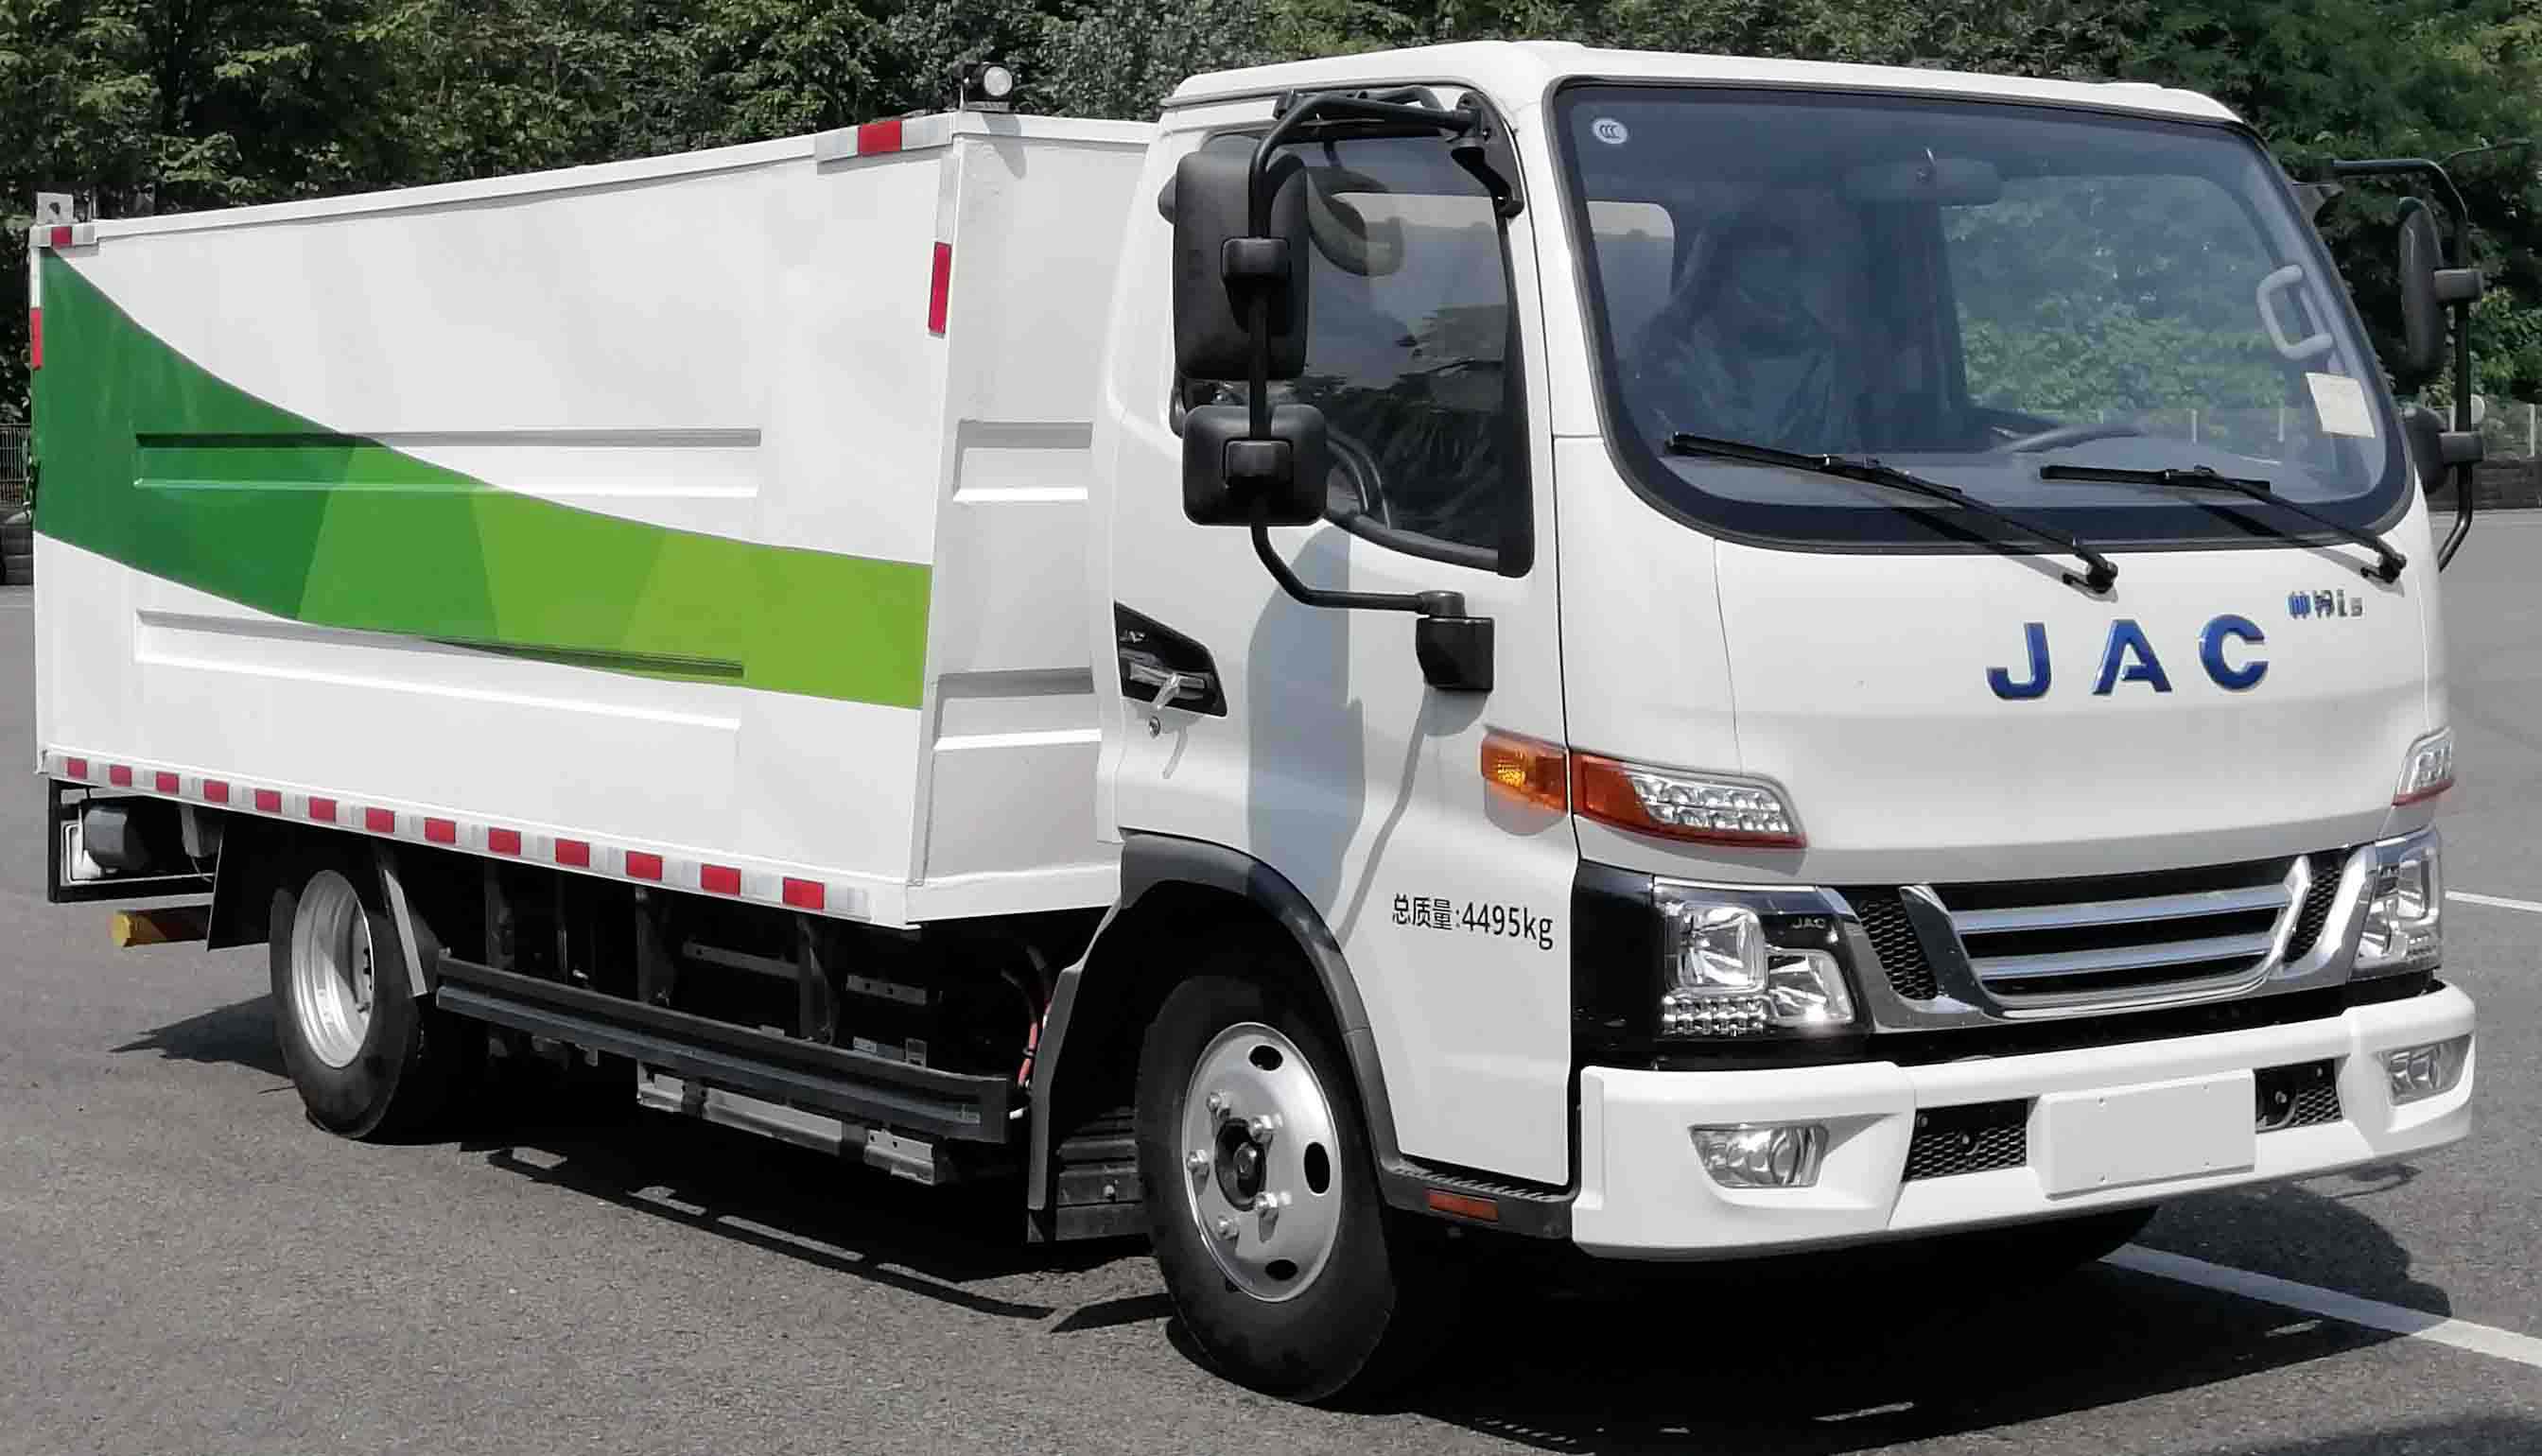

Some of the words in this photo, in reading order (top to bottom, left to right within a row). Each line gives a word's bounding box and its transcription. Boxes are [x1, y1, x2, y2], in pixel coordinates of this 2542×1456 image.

[1986, 614, 2269, 701] JAC
[1392, 893, 1553, 950] 总质量:4495kg
